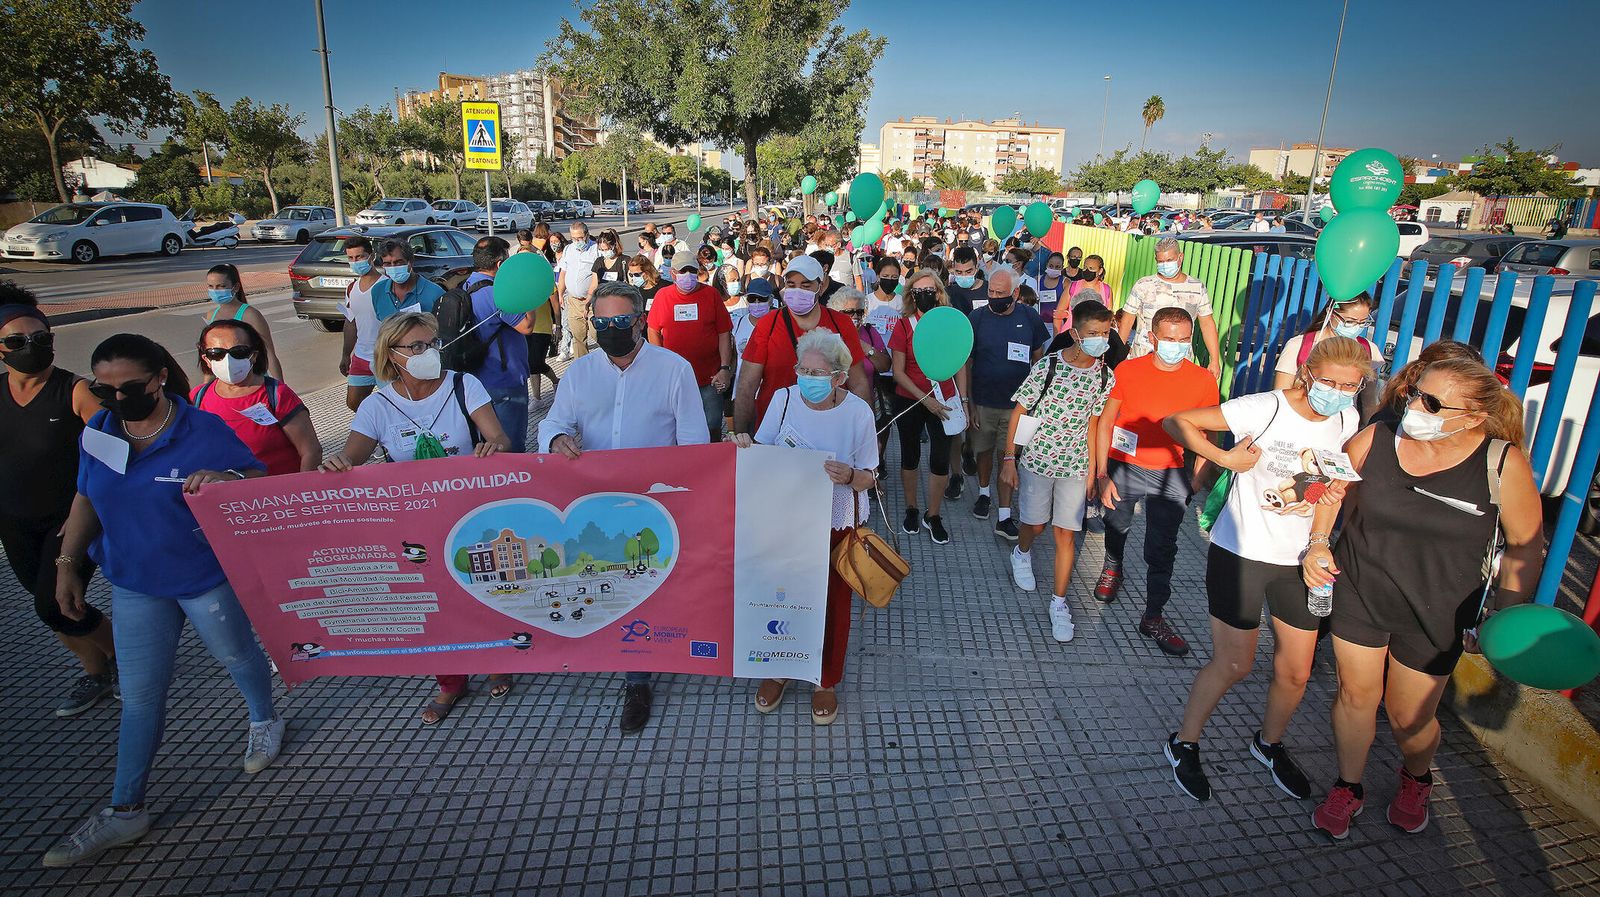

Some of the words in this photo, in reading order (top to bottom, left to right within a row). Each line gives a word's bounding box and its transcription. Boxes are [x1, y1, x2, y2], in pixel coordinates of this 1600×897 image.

[465, 107, 496, 115] ATENCIÓN
[468, 157, 499, 165] PEATONES
[226, 513, 270, 526] 16-22
[274, 509, 298, 520] DE
[301, 501, 401, 517] SEPTIEMBRE
[405, 498, 438, 511] 2021
[260, 524, 285, 533] salud,
[287, 520, 321, 530] muévete
[313, 545, 387, 557] ACTIVIDADES
[307, 551, 397, 565] PROGRAMADAS
[314, 566, 335, 575] Ruta
[336, 564, 372, 573] Solidaria
[293, 578, 316, 587] Feria
[317, 577, 329, 585] de
[339, 575, 378, 583] Movilidad
[379, 574, 420, 582] Sostenible
[329, 585, 378, 595] Bici-Amistad
[285, 601, 311, 611] Fiesta
[312, 599, 326, 607] del
[361, 594, 398, 602] Movilidad
[399, 593, 433, 601] Personal
[748, 601, 789, 609] Ayuntamiento
[301, 608, 339, 617] Jornadas
[347, 606, 388, 614] Campañas
[389, 604, 435, 612] Informativas
[324, 617, 366, 626] Gymkhana
[653, 631, 687, 639] MOBILITY
[346, 648, 390, 656] información
[457, 641, 504, 650] www.jerez.es
[749, 650, 810, 660] PROMEDIOS
